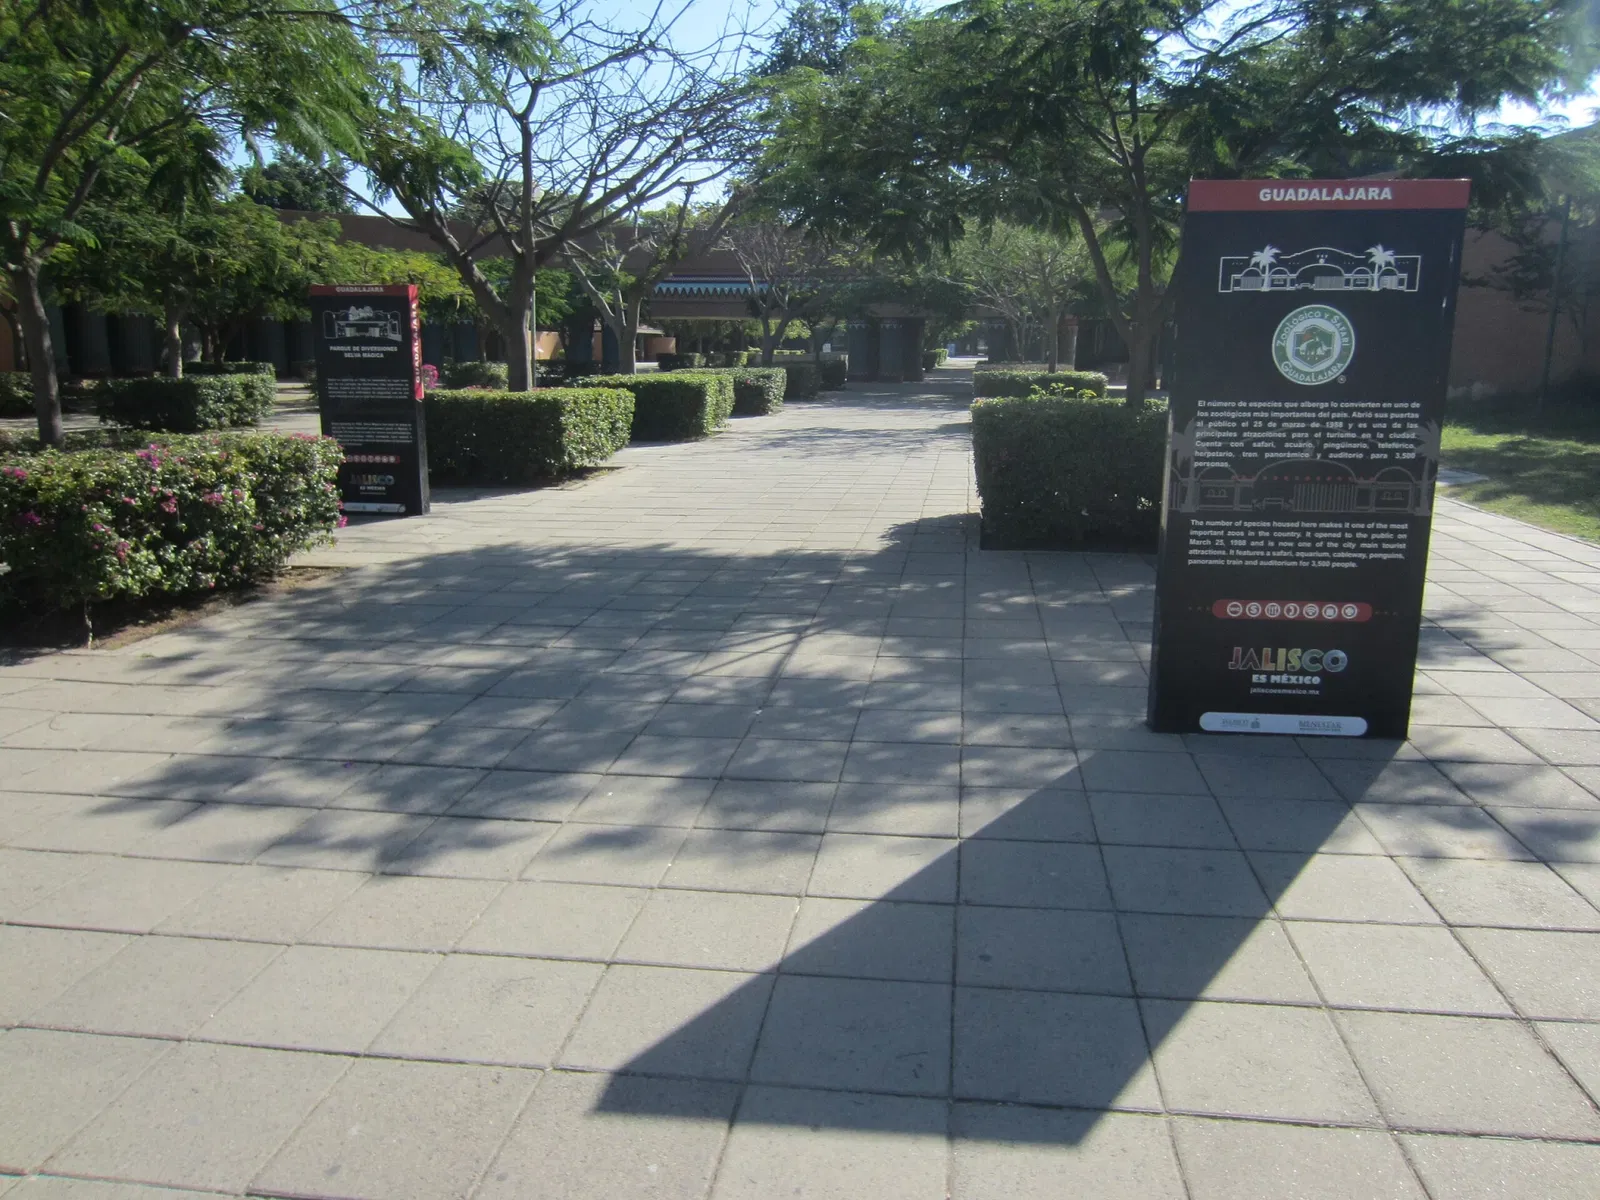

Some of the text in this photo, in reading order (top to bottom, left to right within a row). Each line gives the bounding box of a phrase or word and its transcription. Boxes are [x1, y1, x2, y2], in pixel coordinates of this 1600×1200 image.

[1259, 187, 1393, 202] GUADALAJARA
[411, 303, 420, 383] GUADALAJARA
[1270, 411, 1316, 419] importantes
[1228, 647, 1348, 672] JALISCO
[1252, 675, 1267, 683] ES
